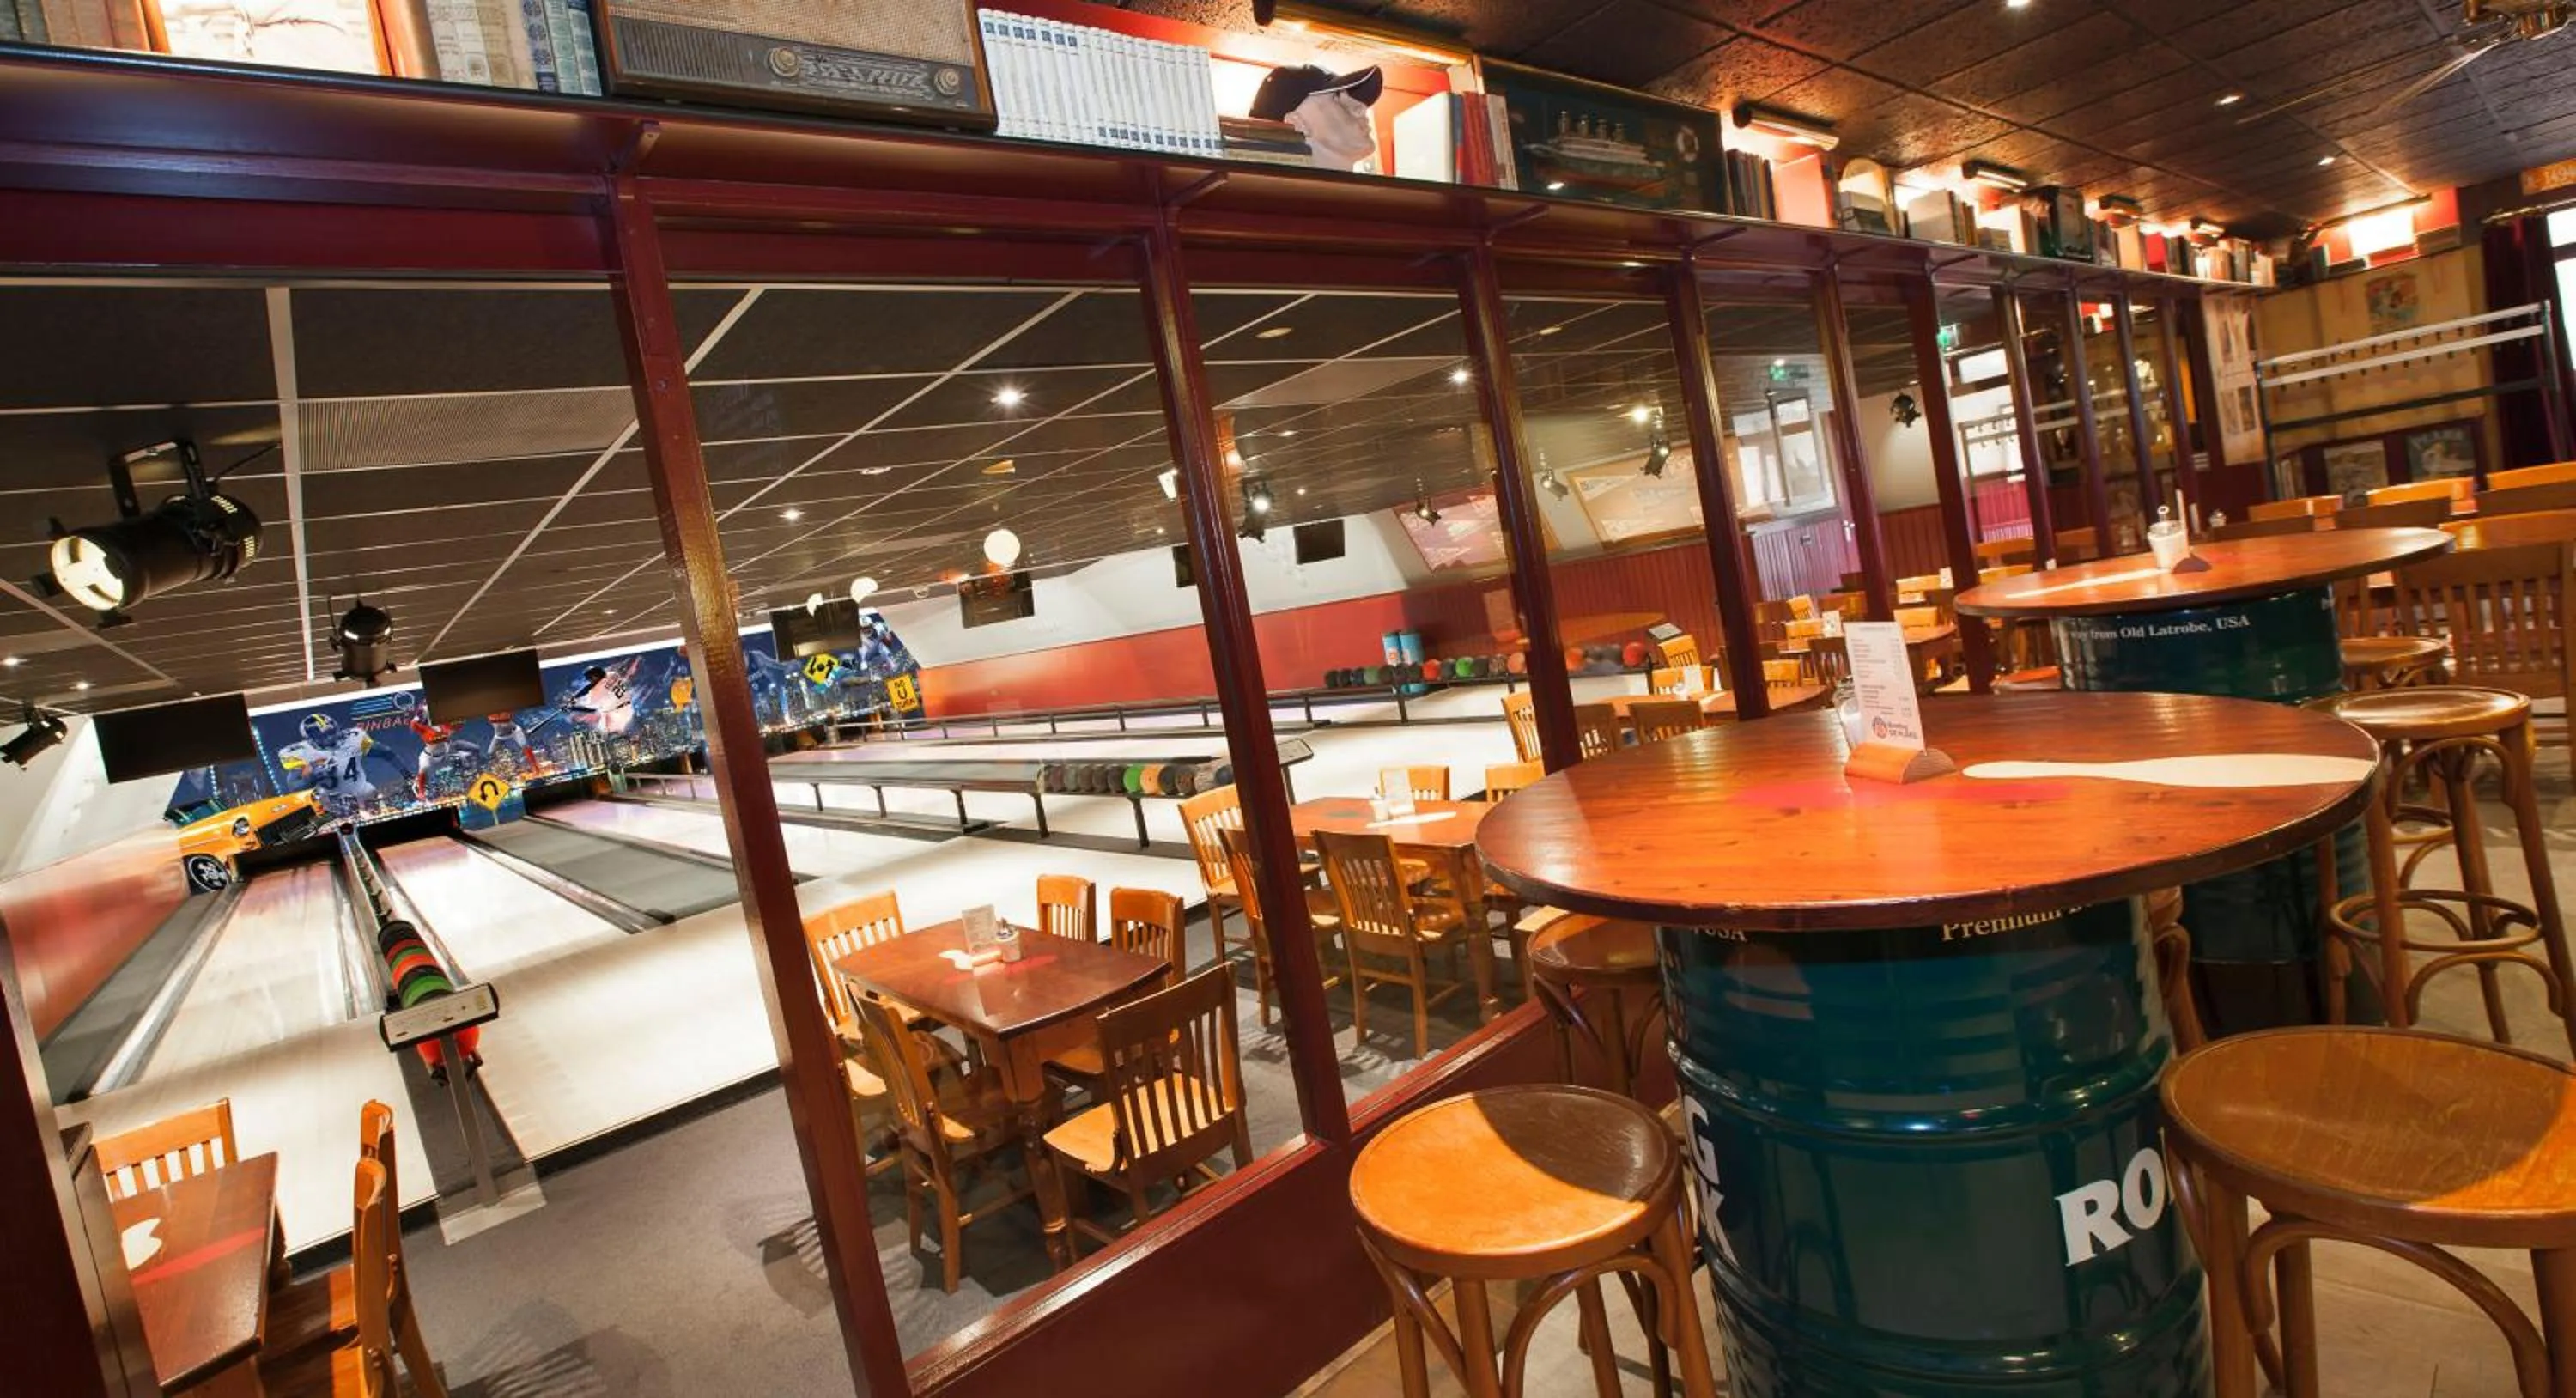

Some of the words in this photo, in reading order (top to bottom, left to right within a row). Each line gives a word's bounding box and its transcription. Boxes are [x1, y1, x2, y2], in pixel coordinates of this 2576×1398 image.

[2119, 626, 2145, 638] Old
[2148, 621, 2213, 637] Latrobe,
[2215, 614, 2251, 629] USA
[2054, 1126, 2175, 1267] RO
